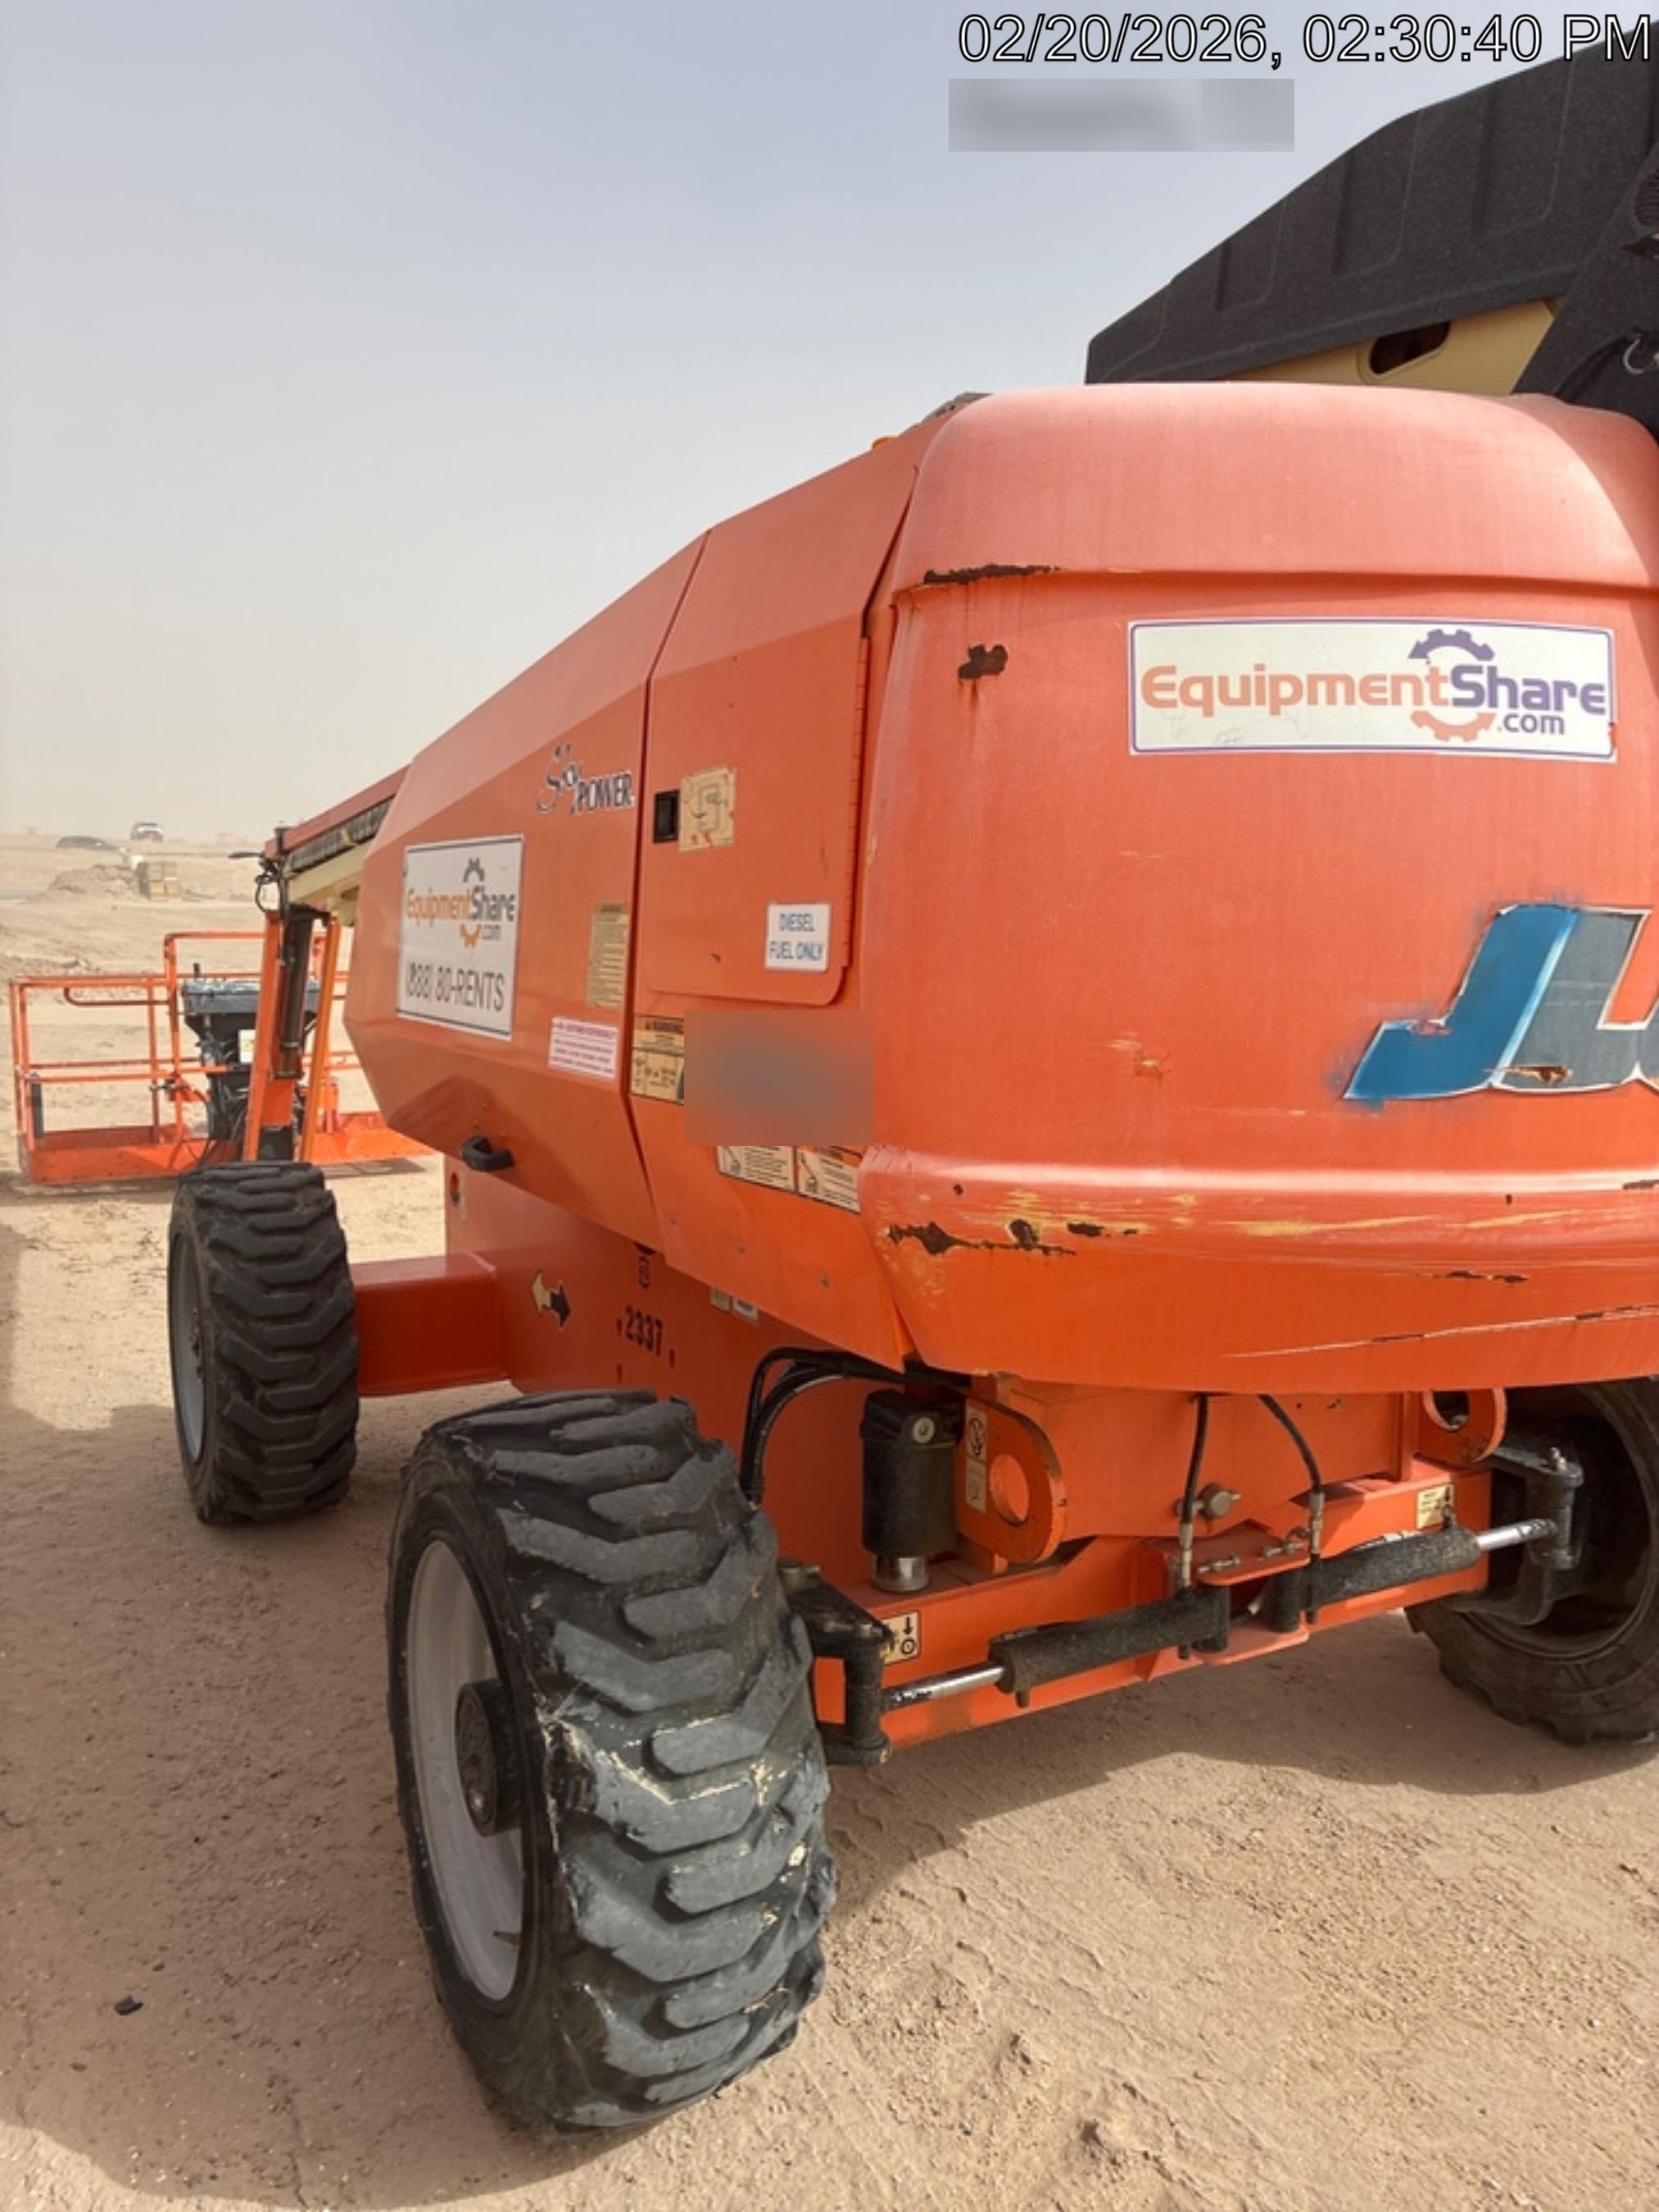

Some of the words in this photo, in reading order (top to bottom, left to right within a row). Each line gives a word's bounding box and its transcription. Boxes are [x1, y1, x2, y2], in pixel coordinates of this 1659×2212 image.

[1140, 663, 1606, 718] EquipmentShare
[1496, 714, 1565, 735] .com
[406, 885, 516, 927] EquipmentShare
[779, 913, 815, 931] DIESEL
[768, 941, 794, 959] FUEL
[796, 941, 825, 962] ONLY
[435, 965, 505, 1013] 80-RENTS
[1344, 904, 1659, 1102] JL
[625, 1305, 664, 1357] 2337
